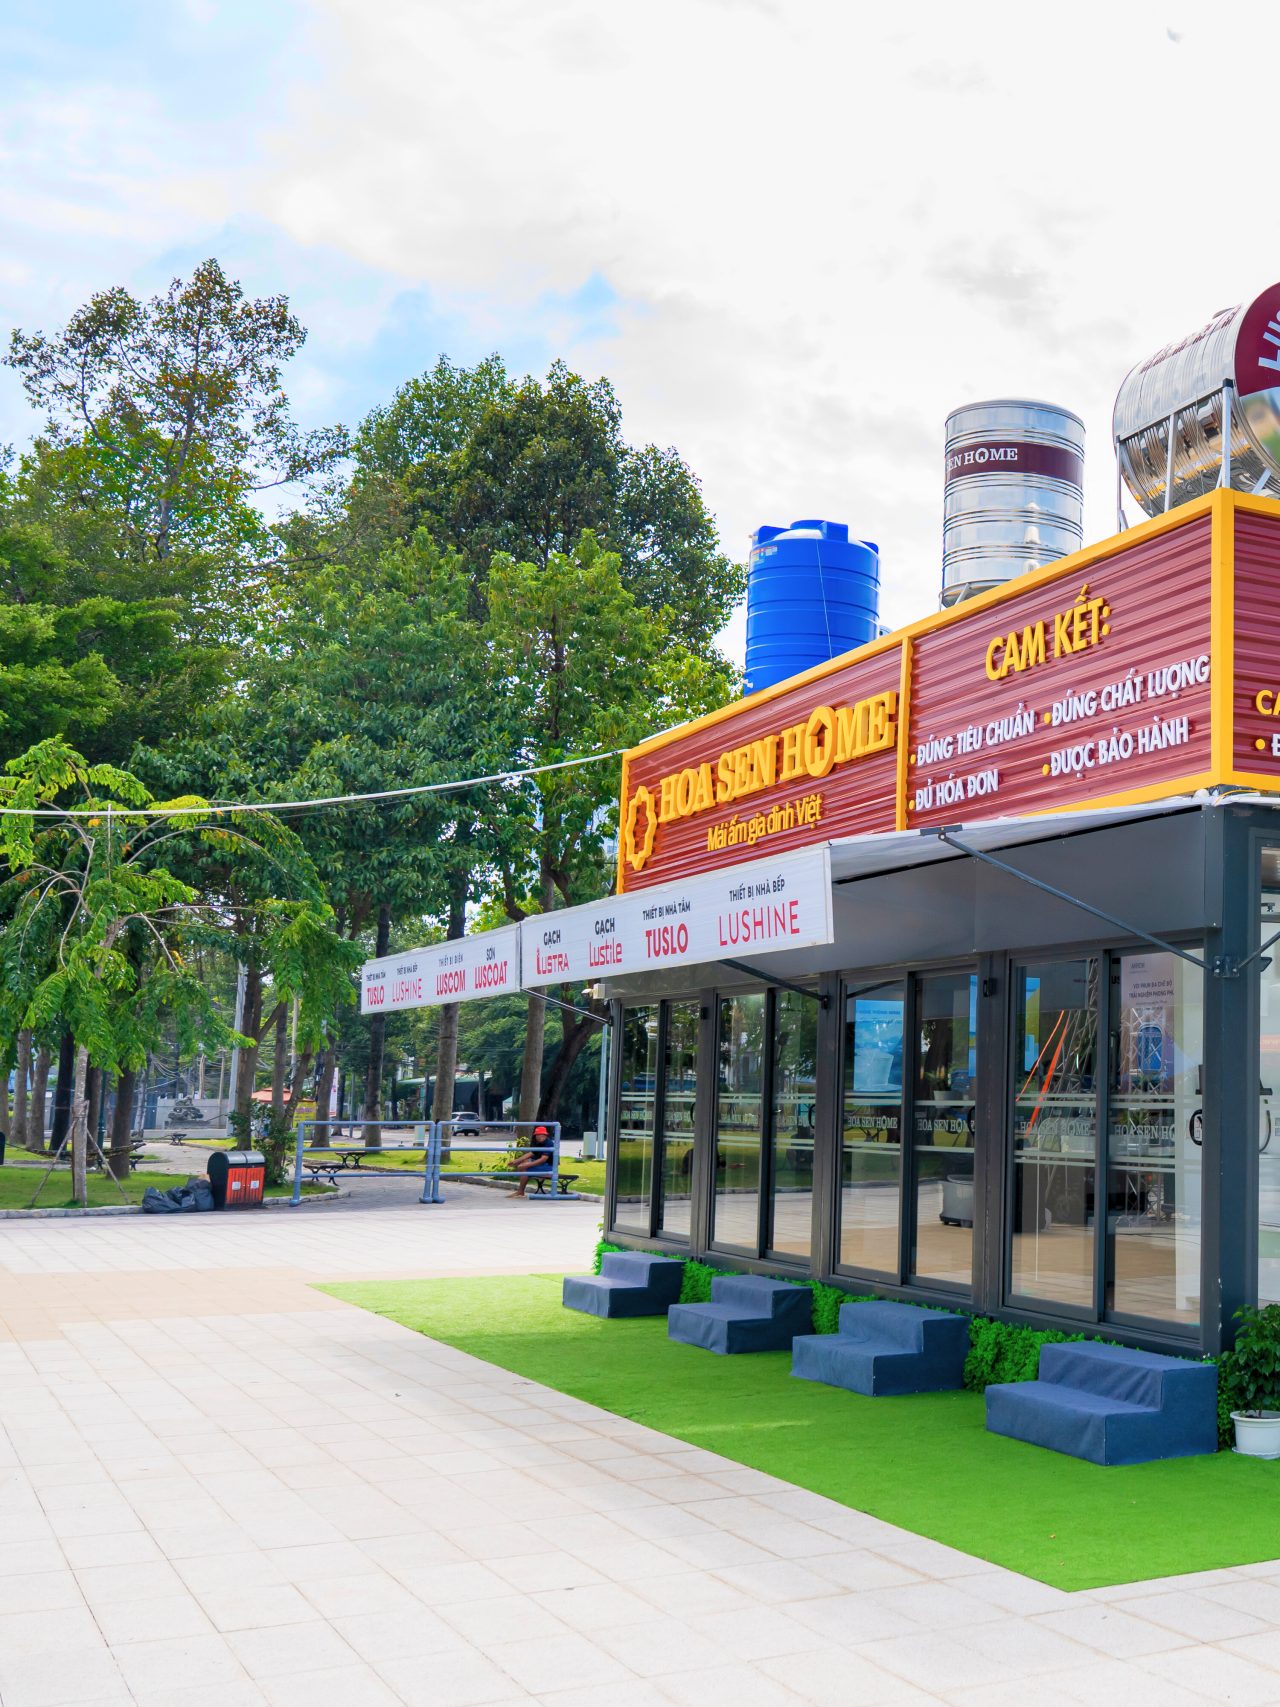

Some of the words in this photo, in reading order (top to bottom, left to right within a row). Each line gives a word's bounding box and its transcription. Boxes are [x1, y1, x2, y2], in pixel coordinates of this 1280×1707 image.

[947, 454, 962, 472] EN
[964, 447, 1018, 465] HOME
[985, 620, 1046, 681] CAM
[1053, 583, 1112, 659] KẾT:
[917, 734, 953, 767] ĐÚNG
[957, 725, 983, 755] TIÊU
[986, 700, 1035, 746] CHUẨN
[1051, 689, 1097, 727] ĐÚNG
[1101, 668, 1144, 711] CHẤT
[1148, 655, 1211, 699] LƯỢNG
[658, 763, 717, 824] HOA
[717, 735, 779, 803] SEN
[780, 690, 897, 778] HOME
[915, 778, 933, 811] ĐỦ
[936, 773, 965, 806] HÓA
[967, 768, 999, 798] ĐƠN
[1050, 742, 1095, 779] ĐƯỢC
[1098, 727, 1133, 765] BẢO
[1137, 715, 1189, 755] HÀNH
[707, 822, 728, 851] Mái
[728, 814, 748, 846] ấm
[747, 812, 766, 845] gia
[767, 802, 795, 834] đình
[796, 793, 823, 829] Việt
[729, 883, 746, 902] THIẾT
[747, 885, 754, 900] BỊ
[755, 879, 771, 897] NHÀ
[772, 874, 785, 893] BẾP
[642, 904, 657, 920] THIẾT
[658, 906, 665, 920] BỊ
[665, 901, 677, 916] NHÀ
[678, 897, 691, 914] TẮM
[594, 918, 615, 938] GẠCH
[719, 900, 801, 946] LUSHINE
[543, 929, 561, 948] GẠCH
[645, 923, 689, 959] TUSLO
[436, 969, 466, 996] LUSCOM
[474, 960, 507, 989] LUSCOAT
[367, 985, 385, 1006] TUSLO
[392, 978, 422, 1002] LUSHINE
[862, 1116, 876, 1128] SEN
[877, 1115, 898, 1129] HOME
[934, 1119, 949, 1131] SEN
[1114, 1125, 1135, 1136] HOA
[1137, 1125, 1159, 1139] SEN
